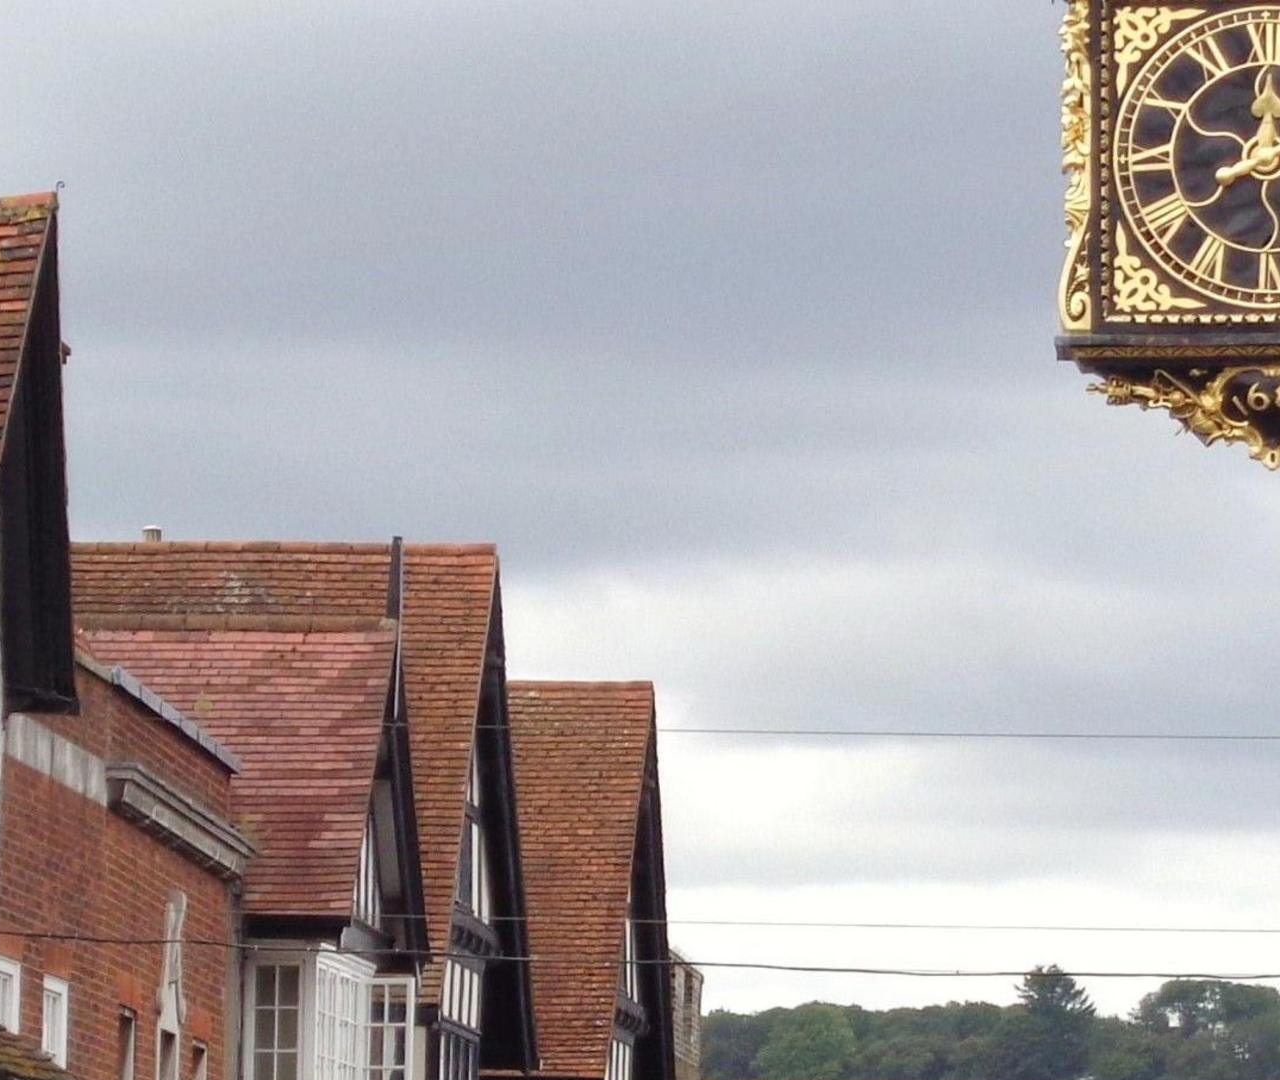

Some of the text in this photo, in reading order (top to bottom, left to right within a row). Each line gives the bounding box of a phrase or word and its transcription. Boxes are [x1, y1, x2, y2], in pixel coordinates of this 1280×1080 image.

[1186, 36, 1231, 82] XI
[1142, 85, 1188, 121] X
[1128, 143, 1172, 172] IX
[1140, 194, 1189, 245] VIII
[1190, 235, 1225, 279] VII
